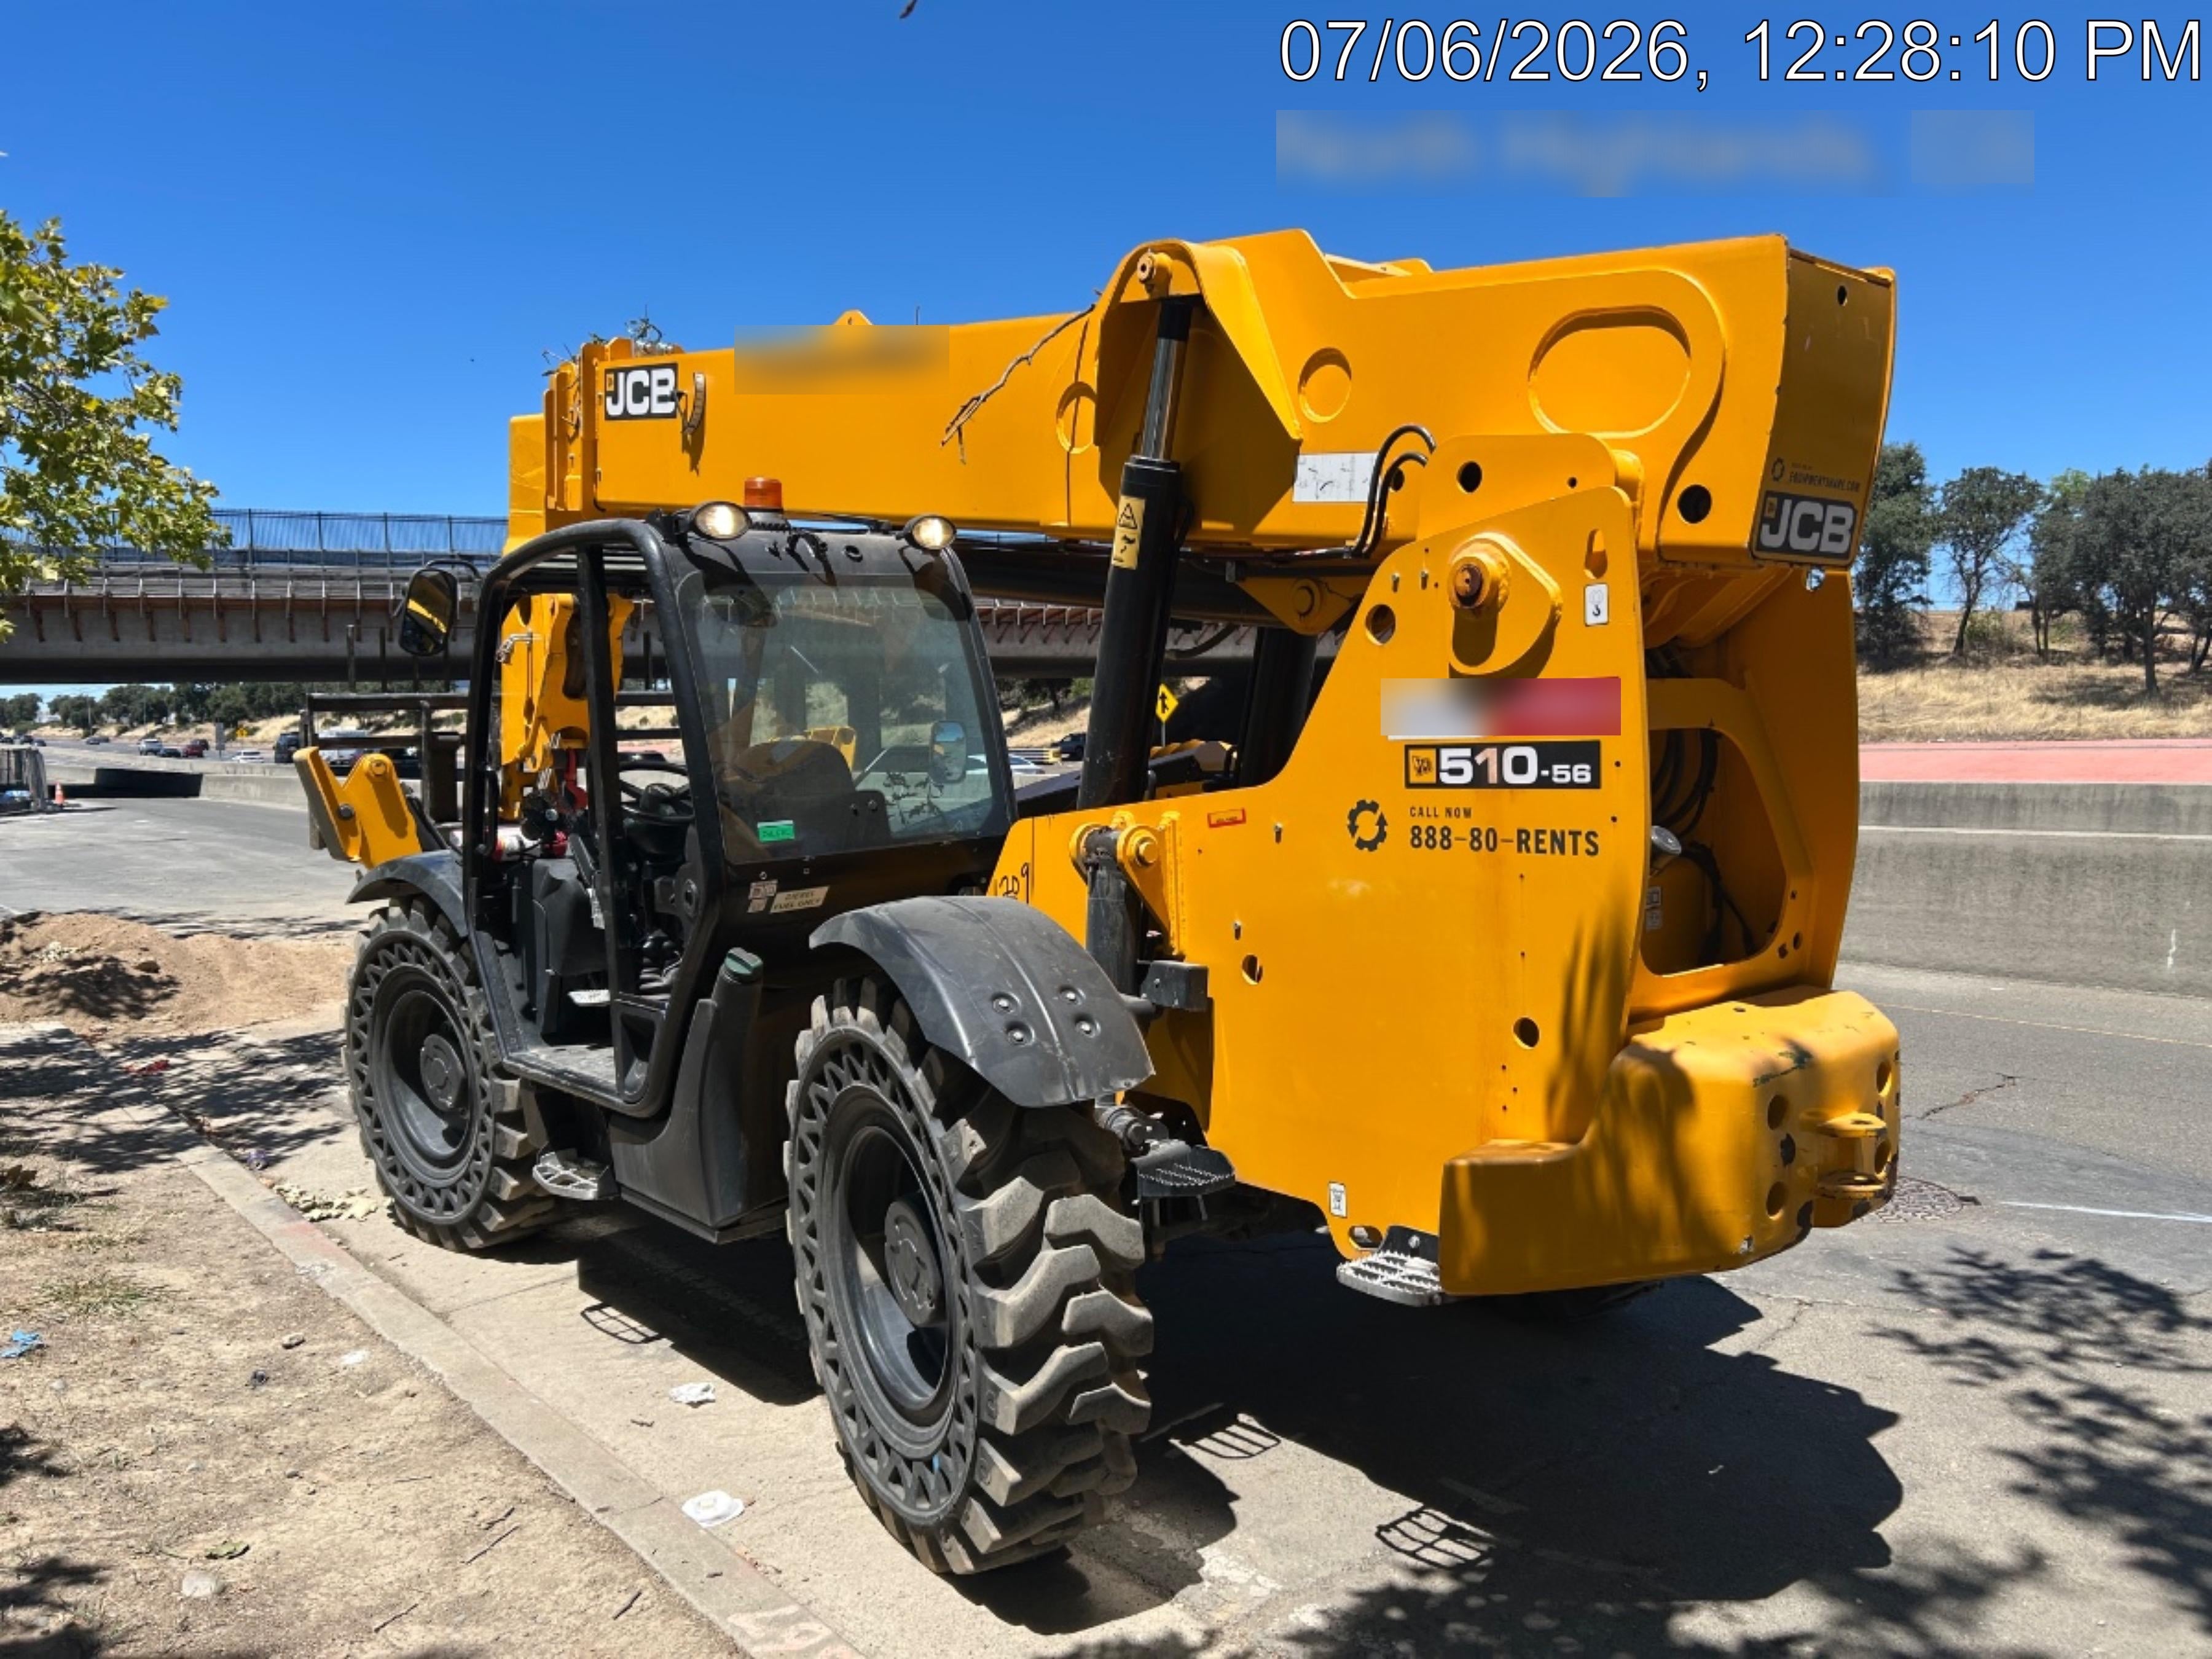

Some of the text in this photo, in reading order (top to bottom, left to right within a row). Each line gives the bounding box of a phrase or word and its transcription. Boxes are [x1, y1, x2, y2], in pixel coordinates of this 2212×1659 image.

[605, 368, 676, 416] JCB
[1760, 498, 1854, 554] JCB
[1438, 745, 1592, 785] 510-56
[1409, 806, 1473, 818] CALL NOW
[1410, 825, 1599, 857] 888-80-RENTS
